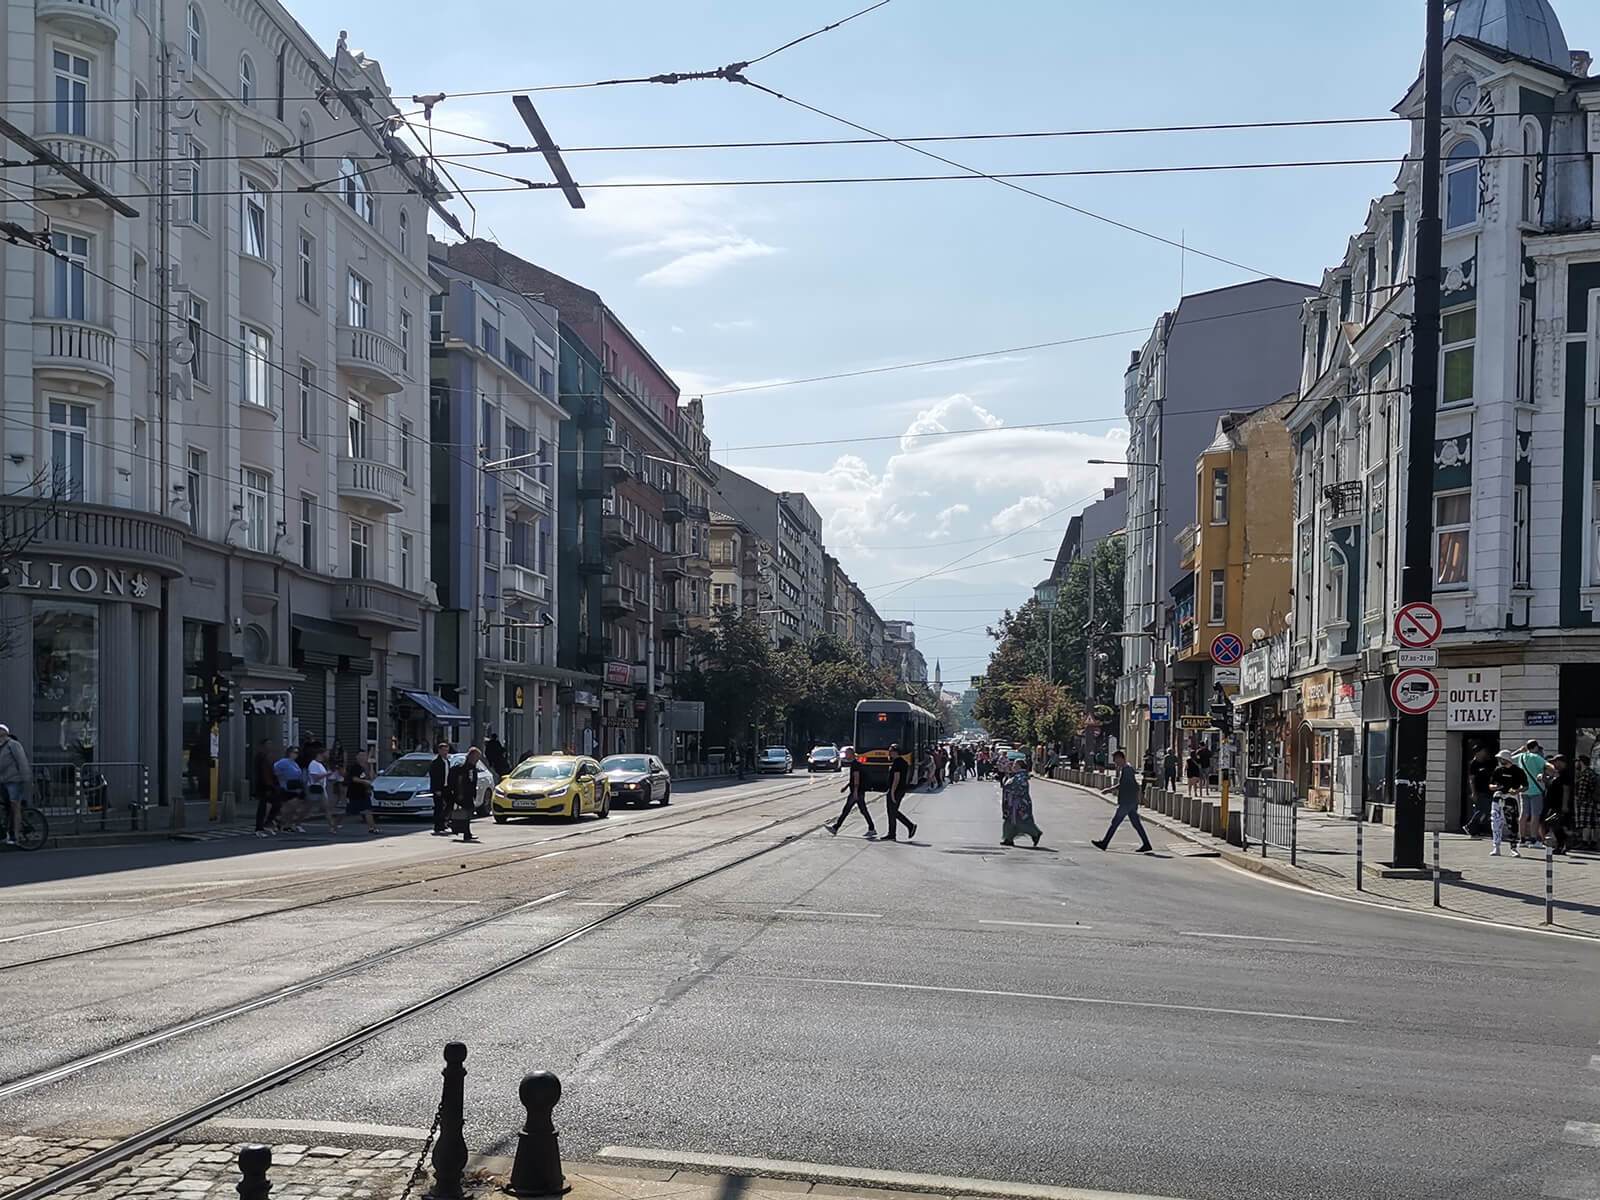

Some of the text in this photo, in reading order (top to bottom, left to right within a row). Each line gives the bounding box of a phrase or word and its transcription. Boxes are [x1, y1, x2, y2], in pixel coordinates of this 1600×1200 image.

[170, 55, 194, 227] HOTEL
[170, 263, 194, 402] LION
[17, 560, 127, 595] LION
[1449, 690, 1498, 703] OUTLET
[1454, 709, 1493, 722] ITALY
